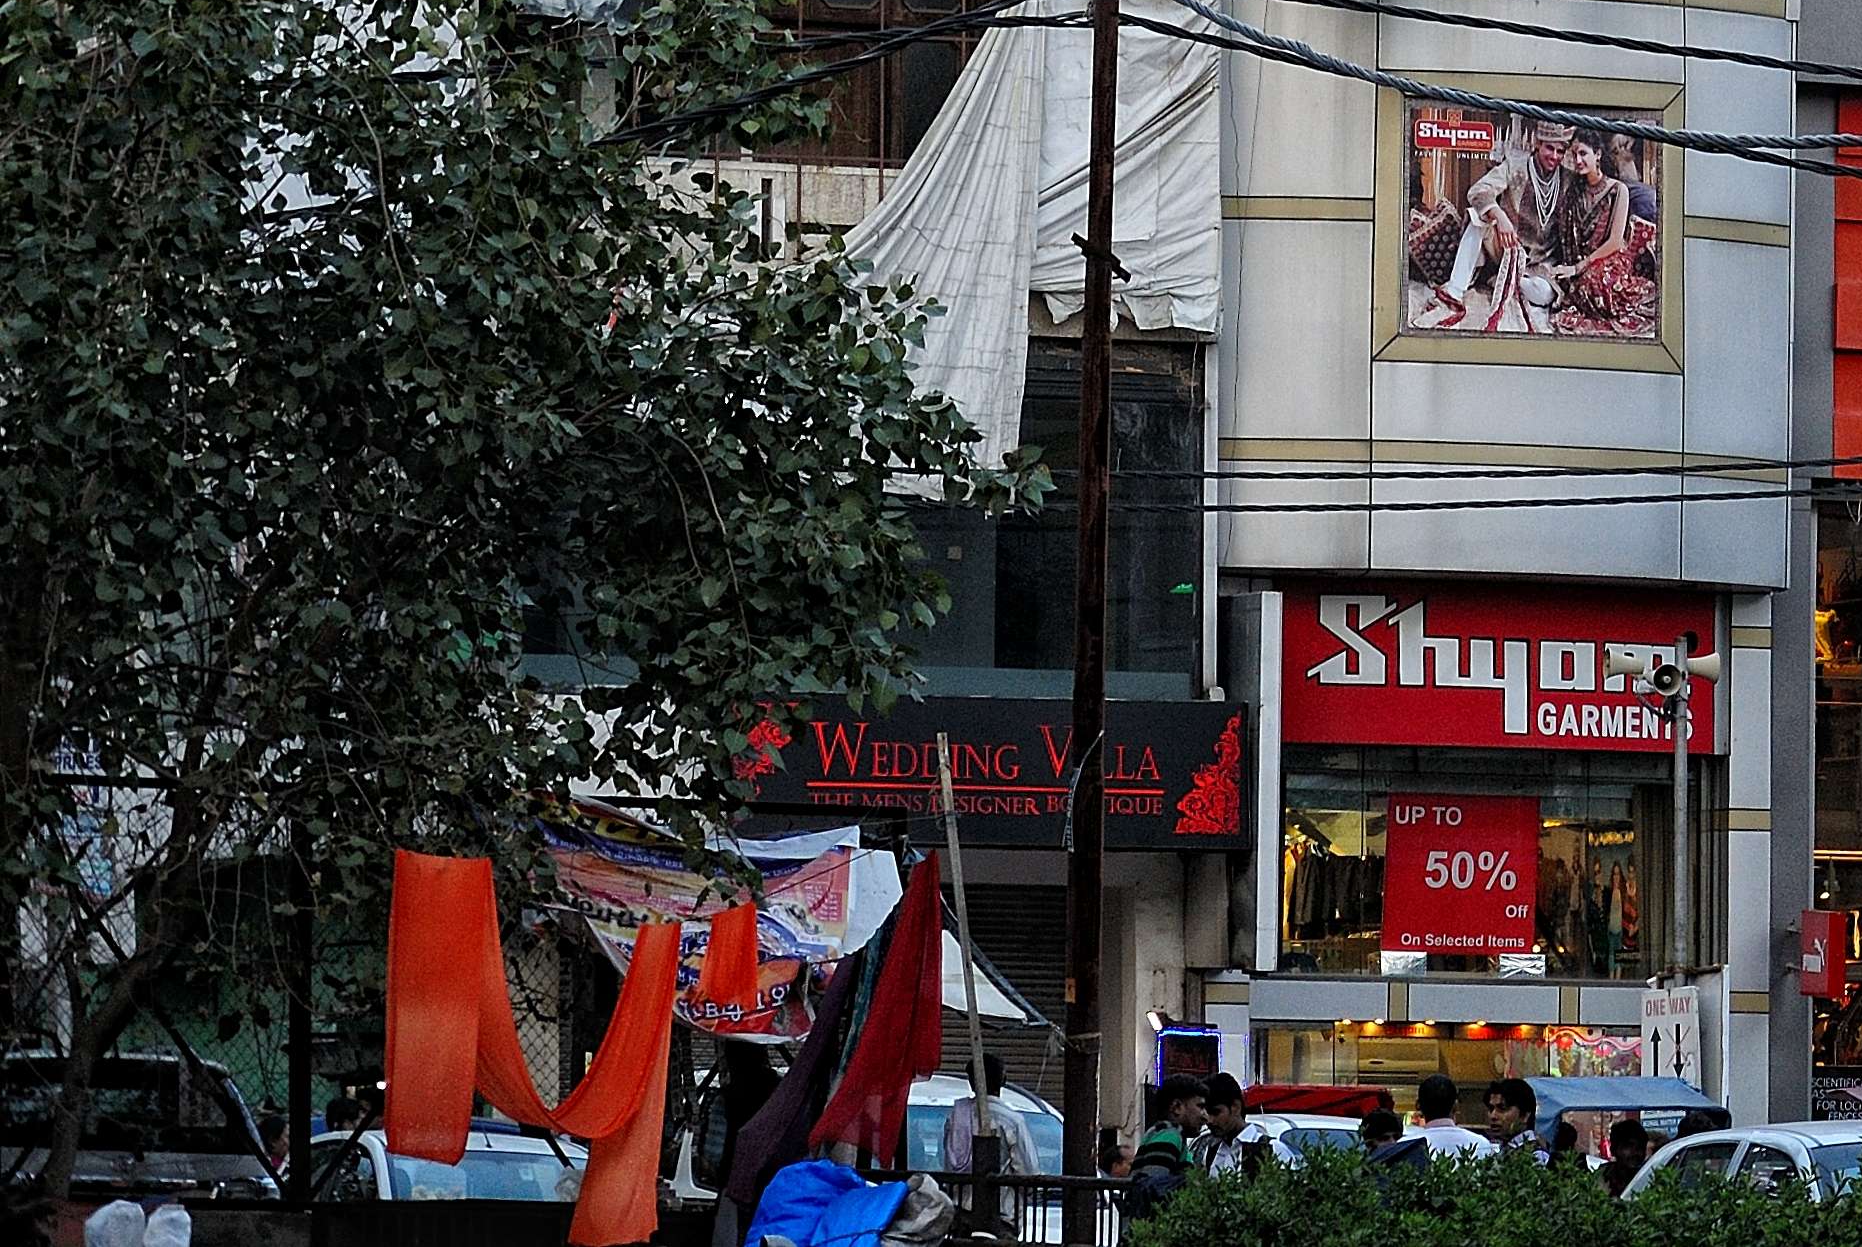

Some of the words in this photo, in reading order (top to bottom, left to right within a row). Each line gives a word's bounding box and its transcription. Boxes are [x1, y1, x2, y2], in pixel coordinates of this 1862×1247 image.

[1418, 122, 1492, 147] Shyam
[1036, 724, 1162, 781] VLA
[1395, 805, 1426, 825] UP
[1432, 806, 1462, 826] TO
[1424, 850, 1518, 891] 50%
[1505, 904, 1529, 919] Off
[1401, 932, 1421, 946] On
[1425, 933, 1484, 947] Selected
[1487, 934, 1525, 948] Items
[1645, 997, 1666, 1017] ONE
[1669, 996, 1692, 1015] WAY
[1816, 1100, 1837, 1111] FOR
